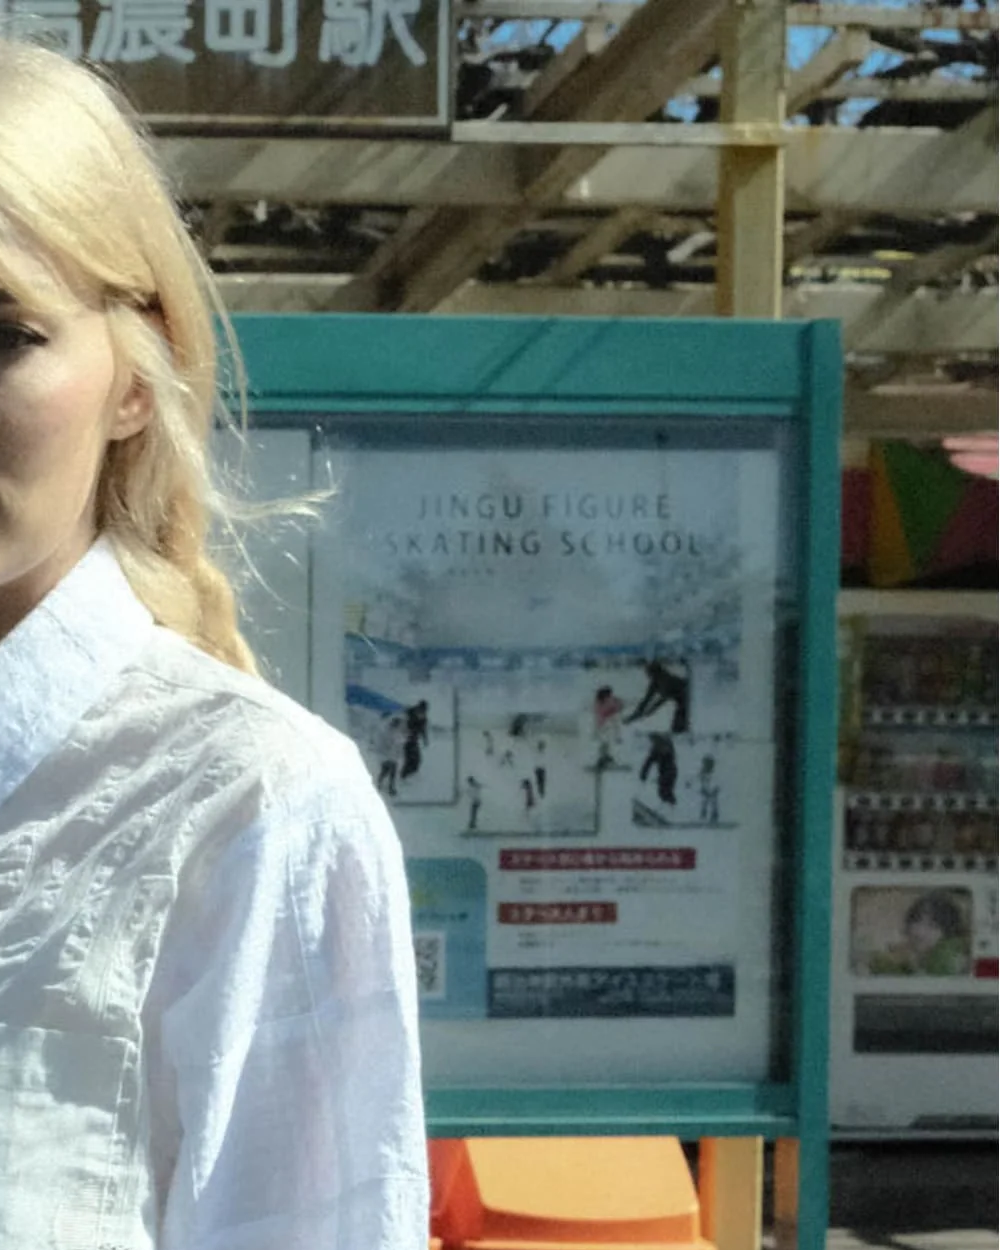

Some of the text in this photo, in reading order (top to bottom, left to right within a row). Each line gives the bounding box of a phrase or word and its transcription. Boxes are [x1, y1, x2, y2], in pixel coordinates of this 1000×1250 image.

[417, 493, 671, 519] JINGU FIGURE
[385, 530, 703, 556] SKATING SCHOOL
